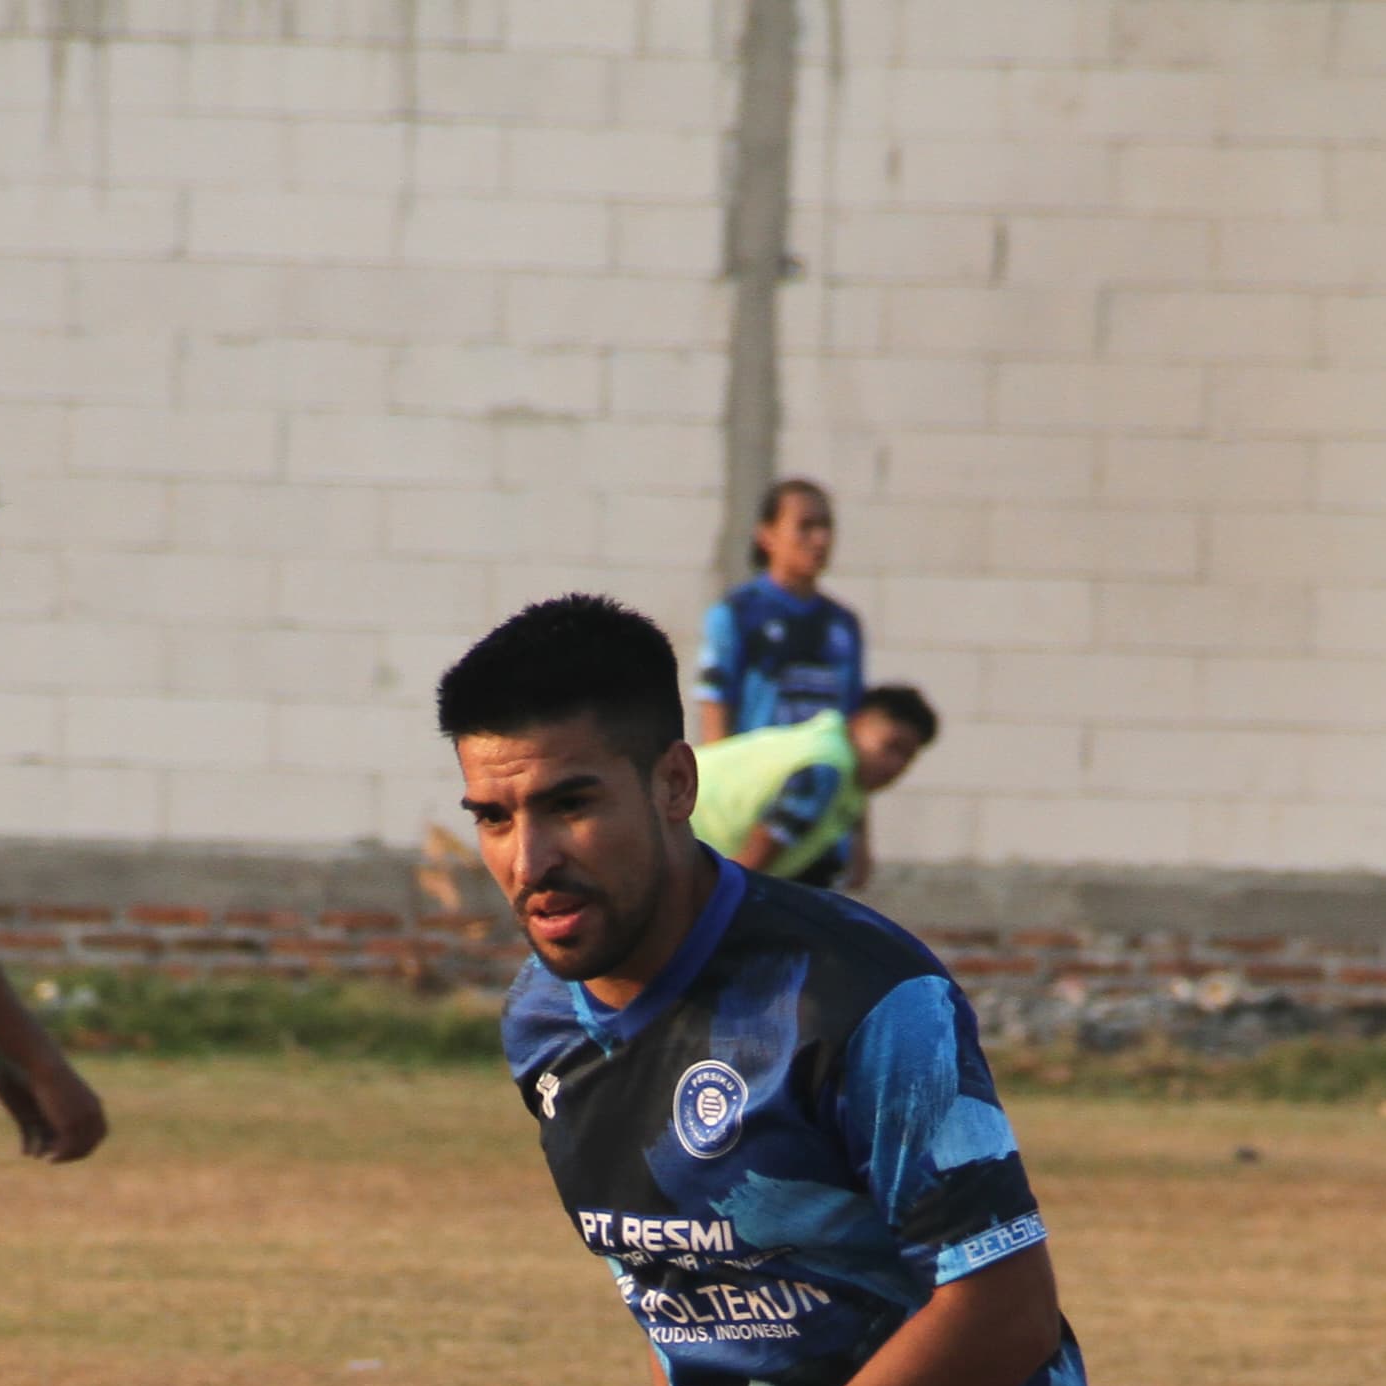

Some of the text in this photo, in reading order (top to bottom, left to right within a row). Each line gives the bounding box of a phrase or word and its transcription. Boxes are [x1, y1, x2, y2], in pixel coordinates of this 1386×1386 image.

[690, 1071, 736, 1092] PERSIKU
[577, 1210, 735, 1253] PT. RESMI
[648, 1323, 801, 1345] KUDUS, INDONESIA
